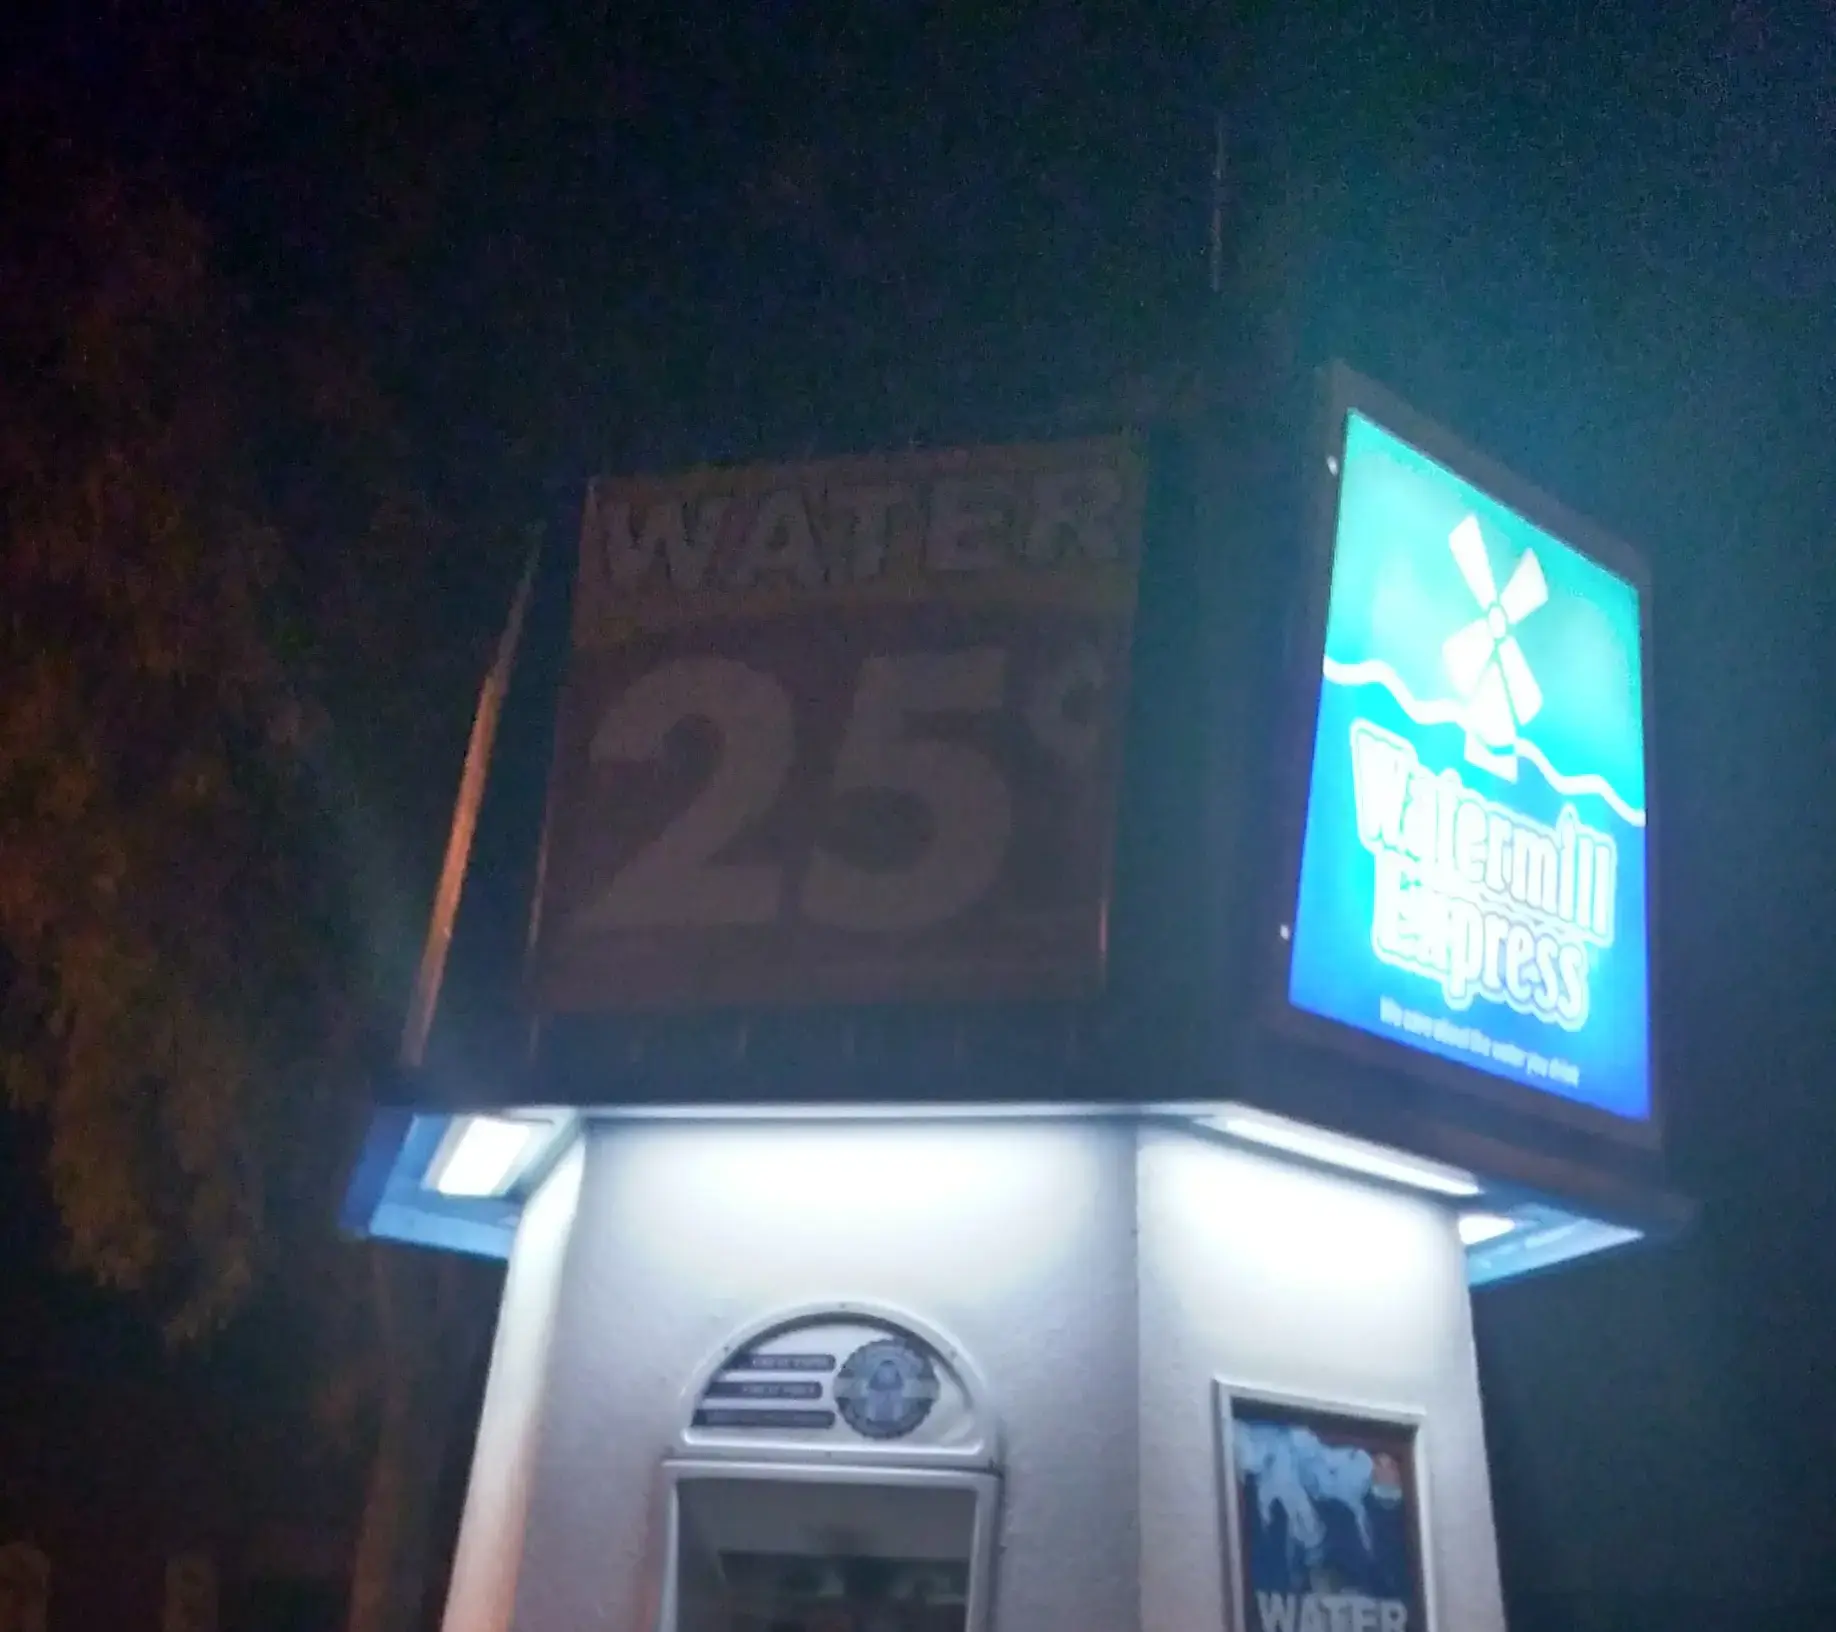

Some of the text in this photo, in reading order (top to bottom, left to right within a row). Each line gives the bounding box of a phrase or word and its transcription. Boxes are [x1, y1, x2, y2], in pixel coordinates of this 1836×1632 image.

[601, 470, 1124, 587] WATER
[1352, 721, 1616, 945] Watermill
[1374, 854, 1588, 1030] Express
